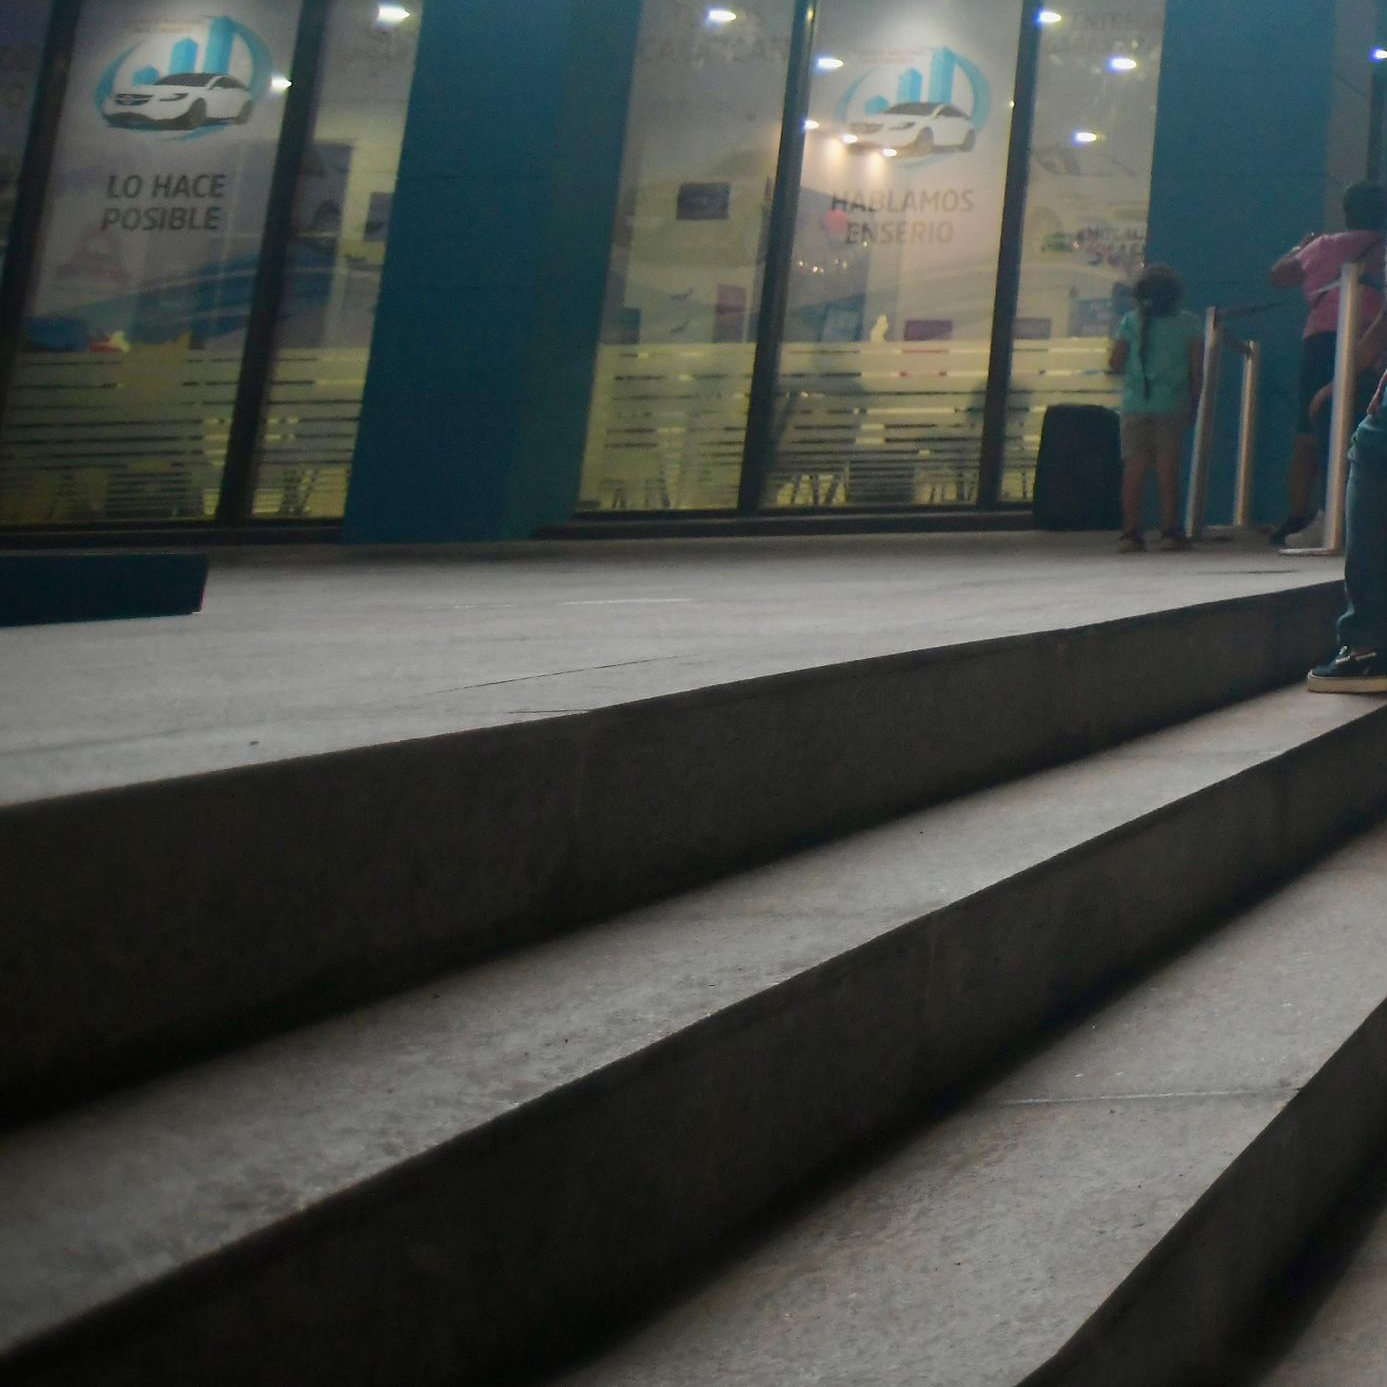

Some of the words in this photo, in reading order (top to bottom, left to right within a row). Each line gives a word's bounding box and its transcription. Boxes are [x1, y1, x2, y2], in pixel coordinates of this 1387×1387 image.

[108, 174, 143, 198] LO
[153, 173, 226, 198] HACE
[831, 189, 973, 212] HABLAMOS
[101, 206, 221, 230] POSIBLE
